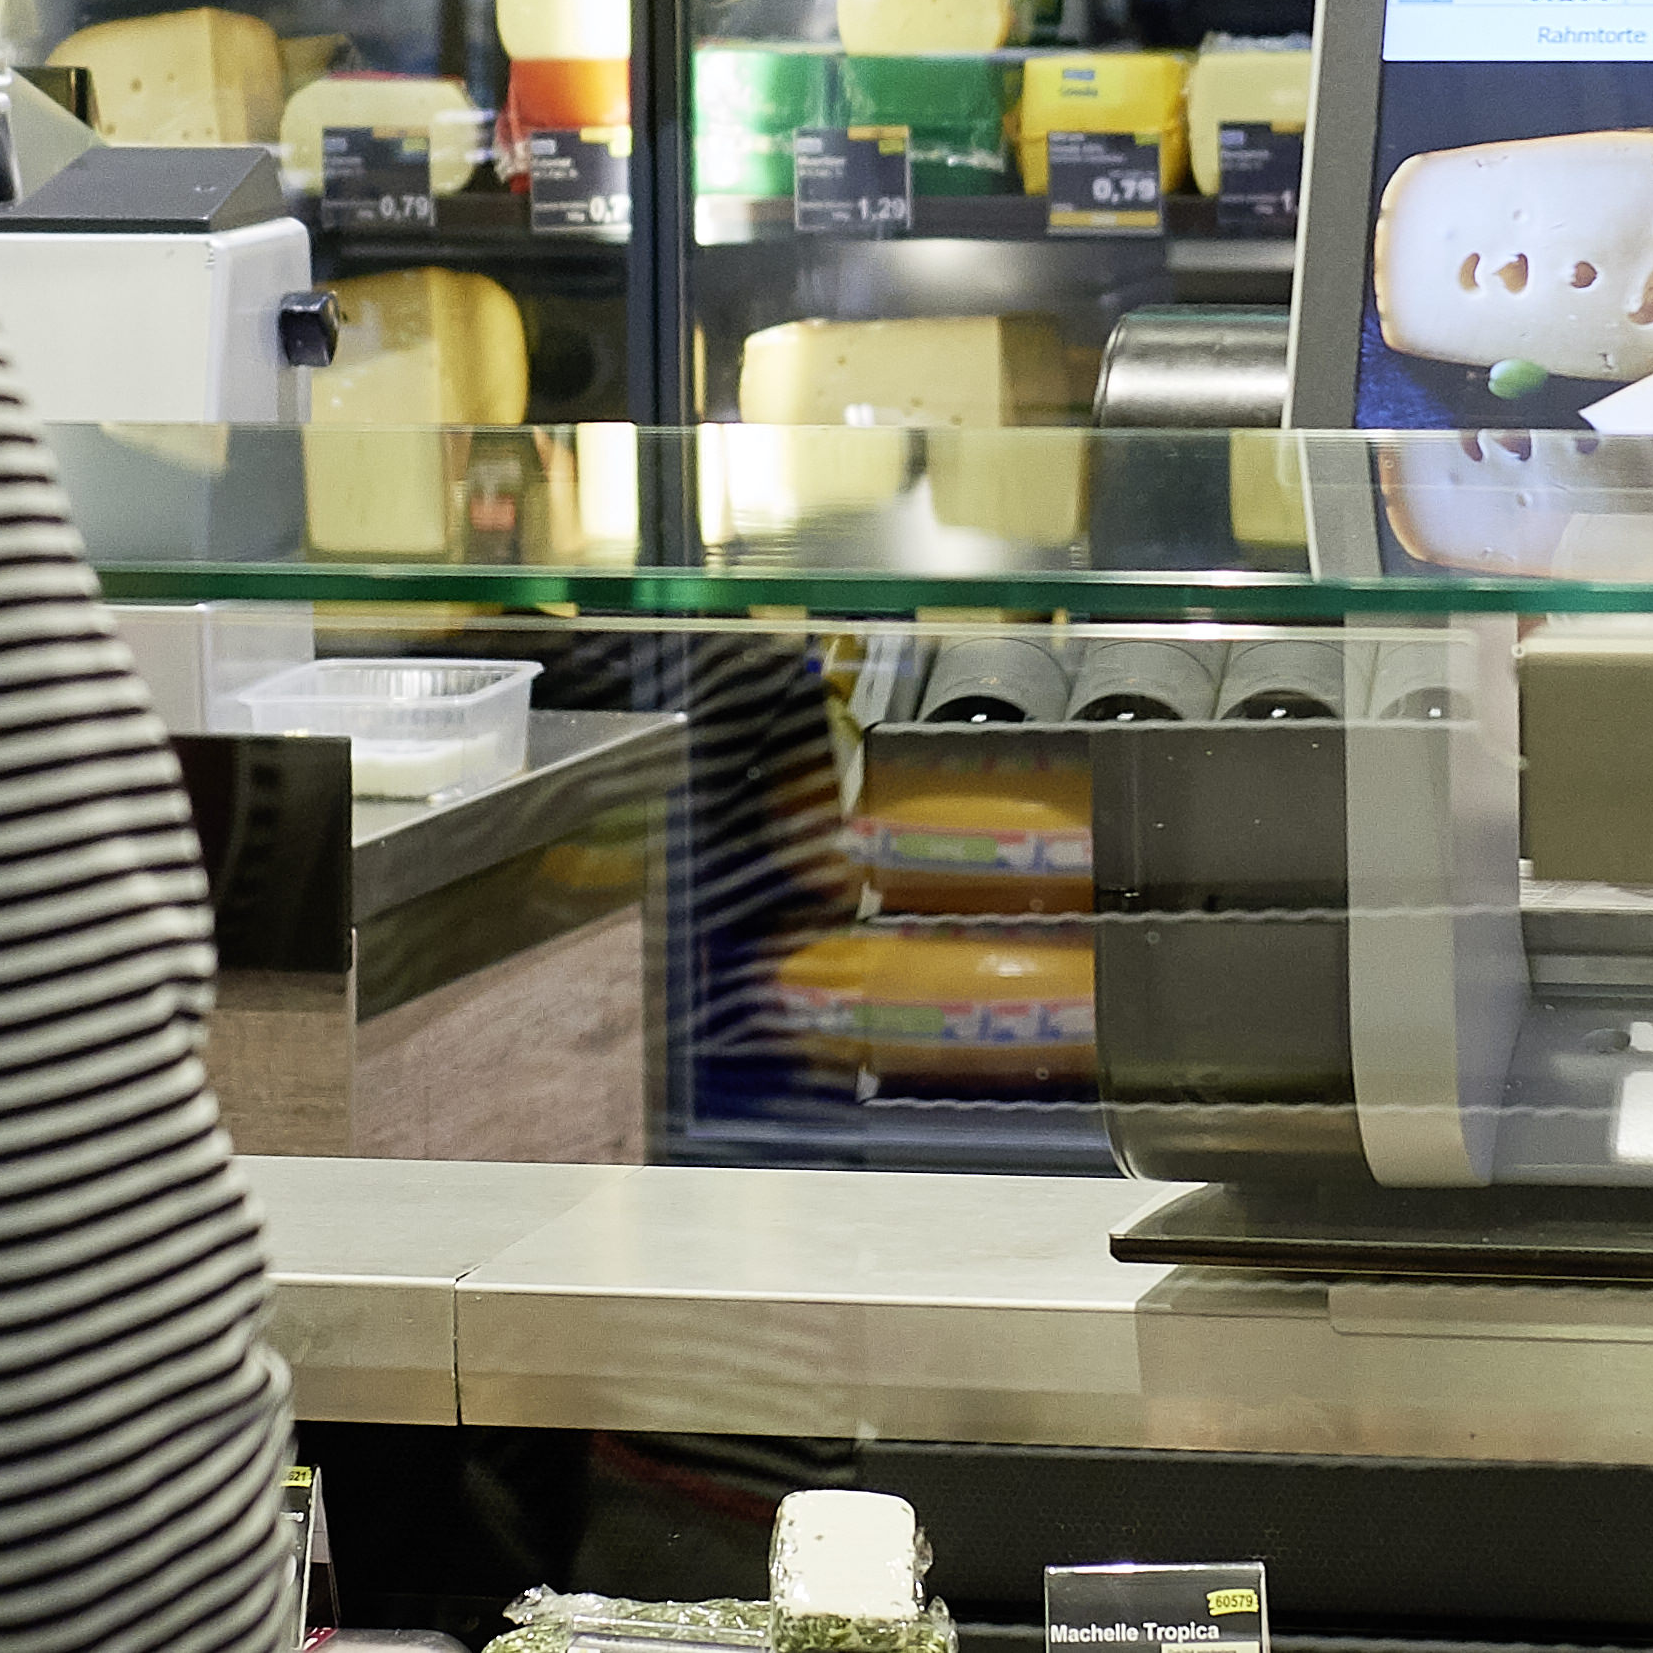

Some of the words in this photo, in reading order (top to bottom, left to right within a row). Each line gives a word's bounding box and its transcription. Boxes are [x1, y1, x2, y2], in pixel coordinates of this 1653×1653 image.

[1537, 25, 1647, 45] Rahmtorte
[1215, 1593, 1254, 1609] 60579
[1050, 1623, 1140, 1643] Machelle
[1143, 1621, 1220, 1644] Tropica
